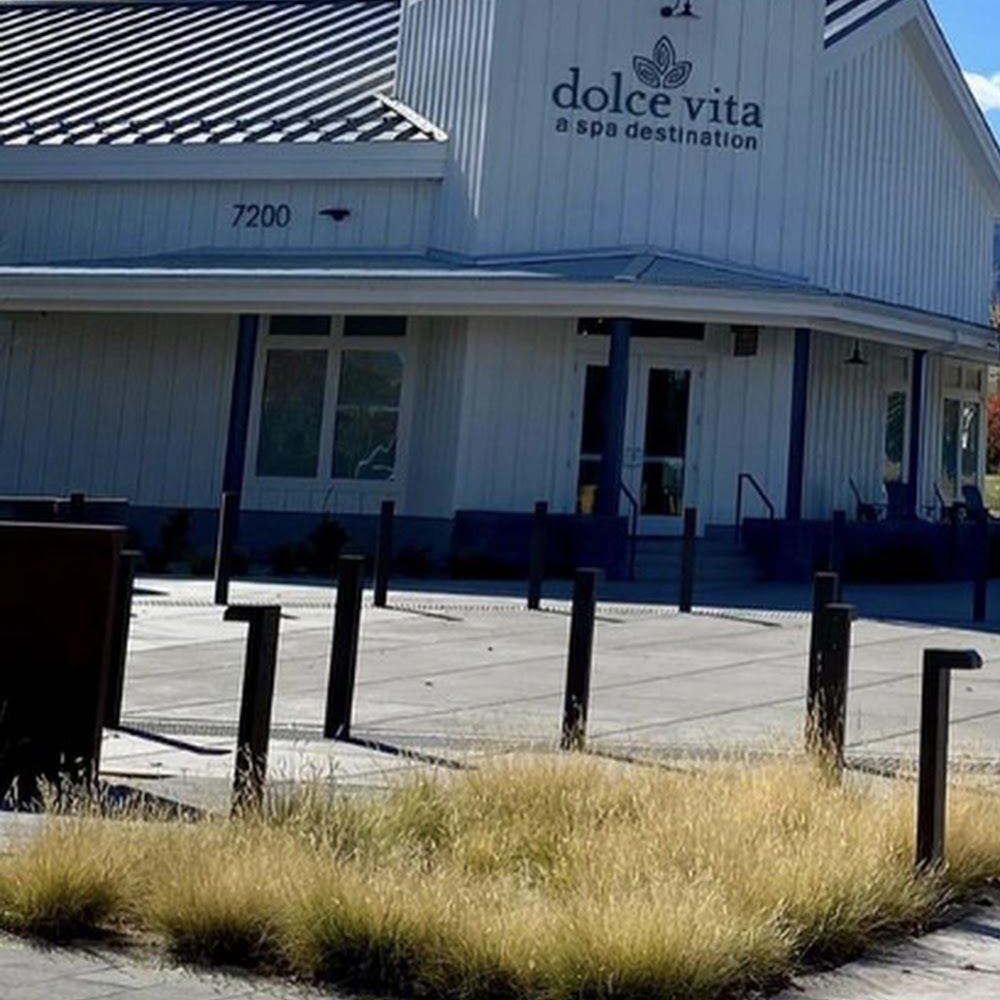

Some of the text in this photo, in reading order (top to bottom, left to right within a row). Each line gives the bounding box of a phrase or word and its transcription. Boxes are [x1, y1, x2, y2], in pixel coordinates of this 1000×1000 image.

[552, 66, 763, 128] dolce vita
[555, 117, 758, 150] a spa destination
[231, 203, 291, 228] 7200
